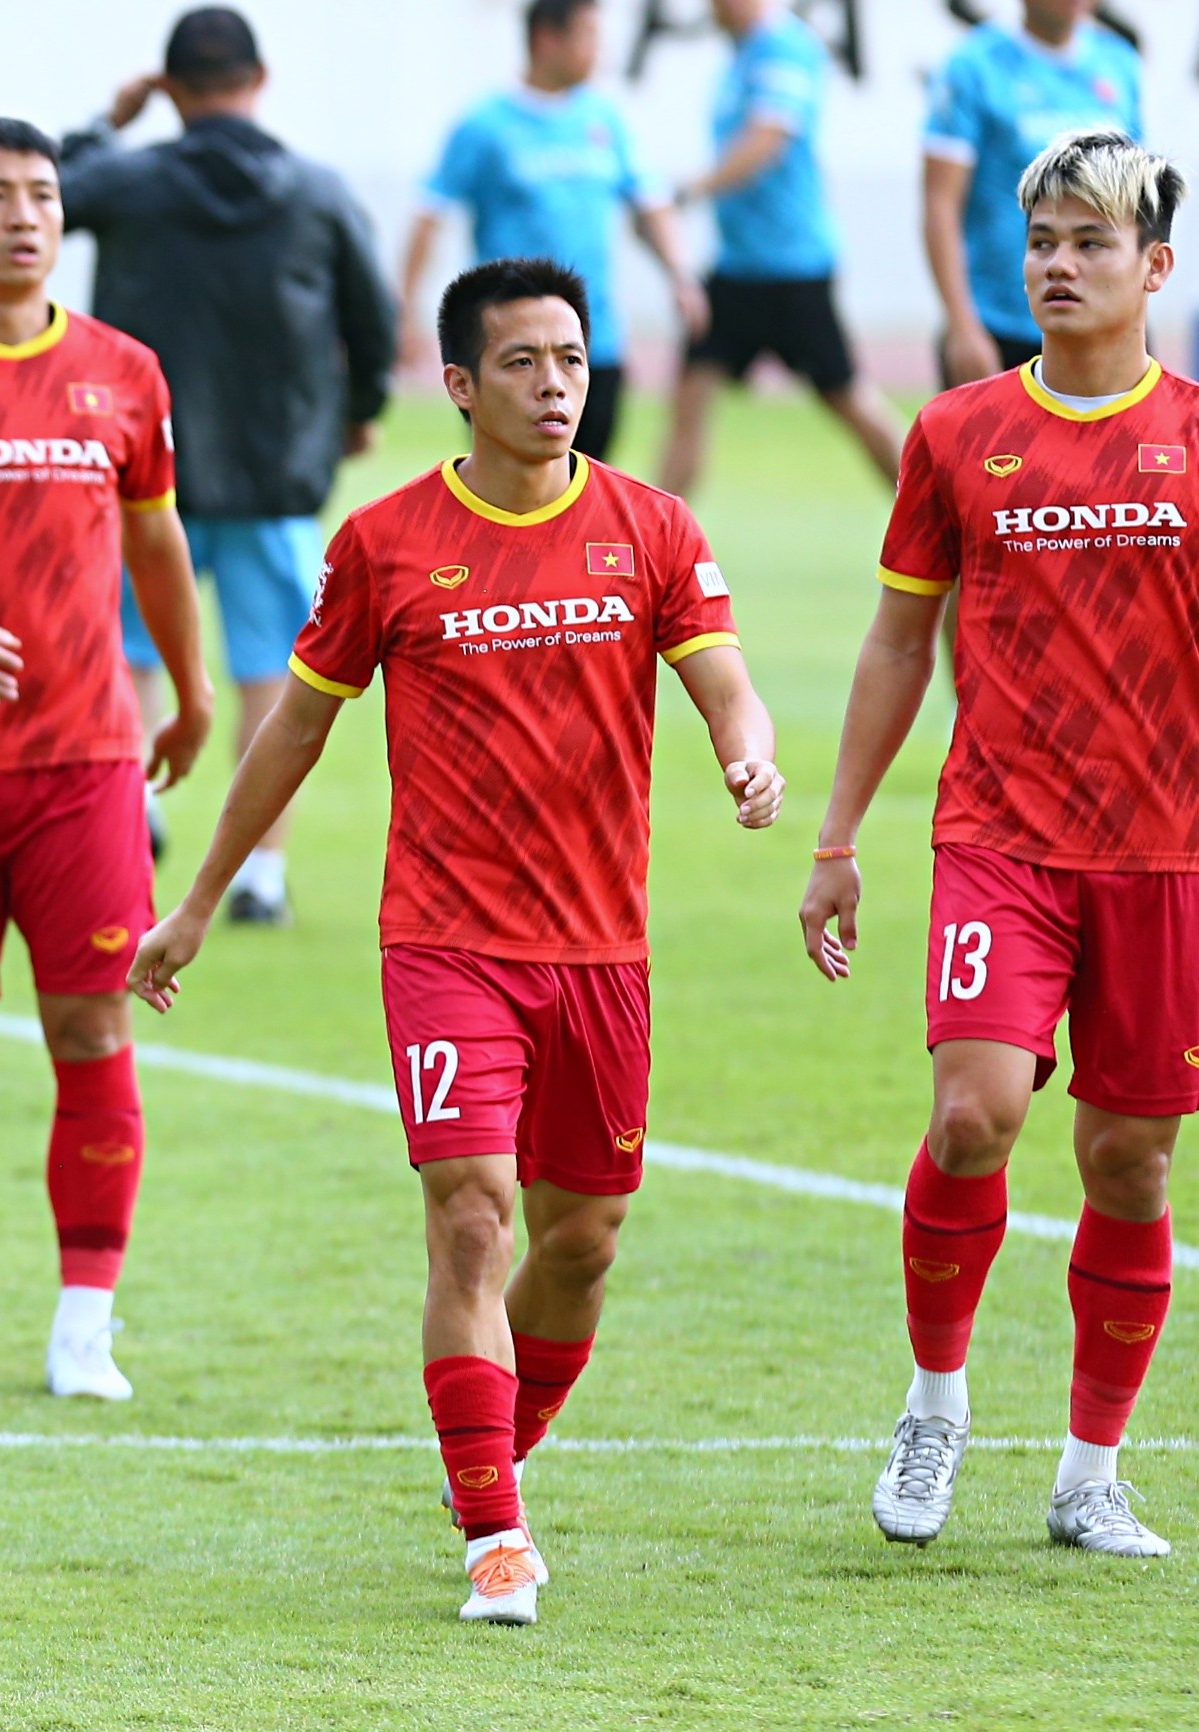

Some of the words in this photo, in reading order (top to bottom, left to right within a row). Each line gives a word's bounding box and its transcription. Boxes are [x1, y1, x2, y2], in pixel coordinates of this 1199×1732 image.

[992, 502, 1188, 535] HONDA
[1003, 539, 1033, 552] The
[1036, 537, 1090, 551] Power
[1094, 534, 1113, 548] of
[1116, 534, 1181, 547] Dreams
[439, 595, 635, 640] HONDA
[458, 642, 489, 656] The
[491, 637, 542, 652] Power
[544, 632, 563, 646] of
[565, 630, 622, 645] Dreams
[939, 920, 993, 1003] 13
[406, 1040, 461, 1125] 12
